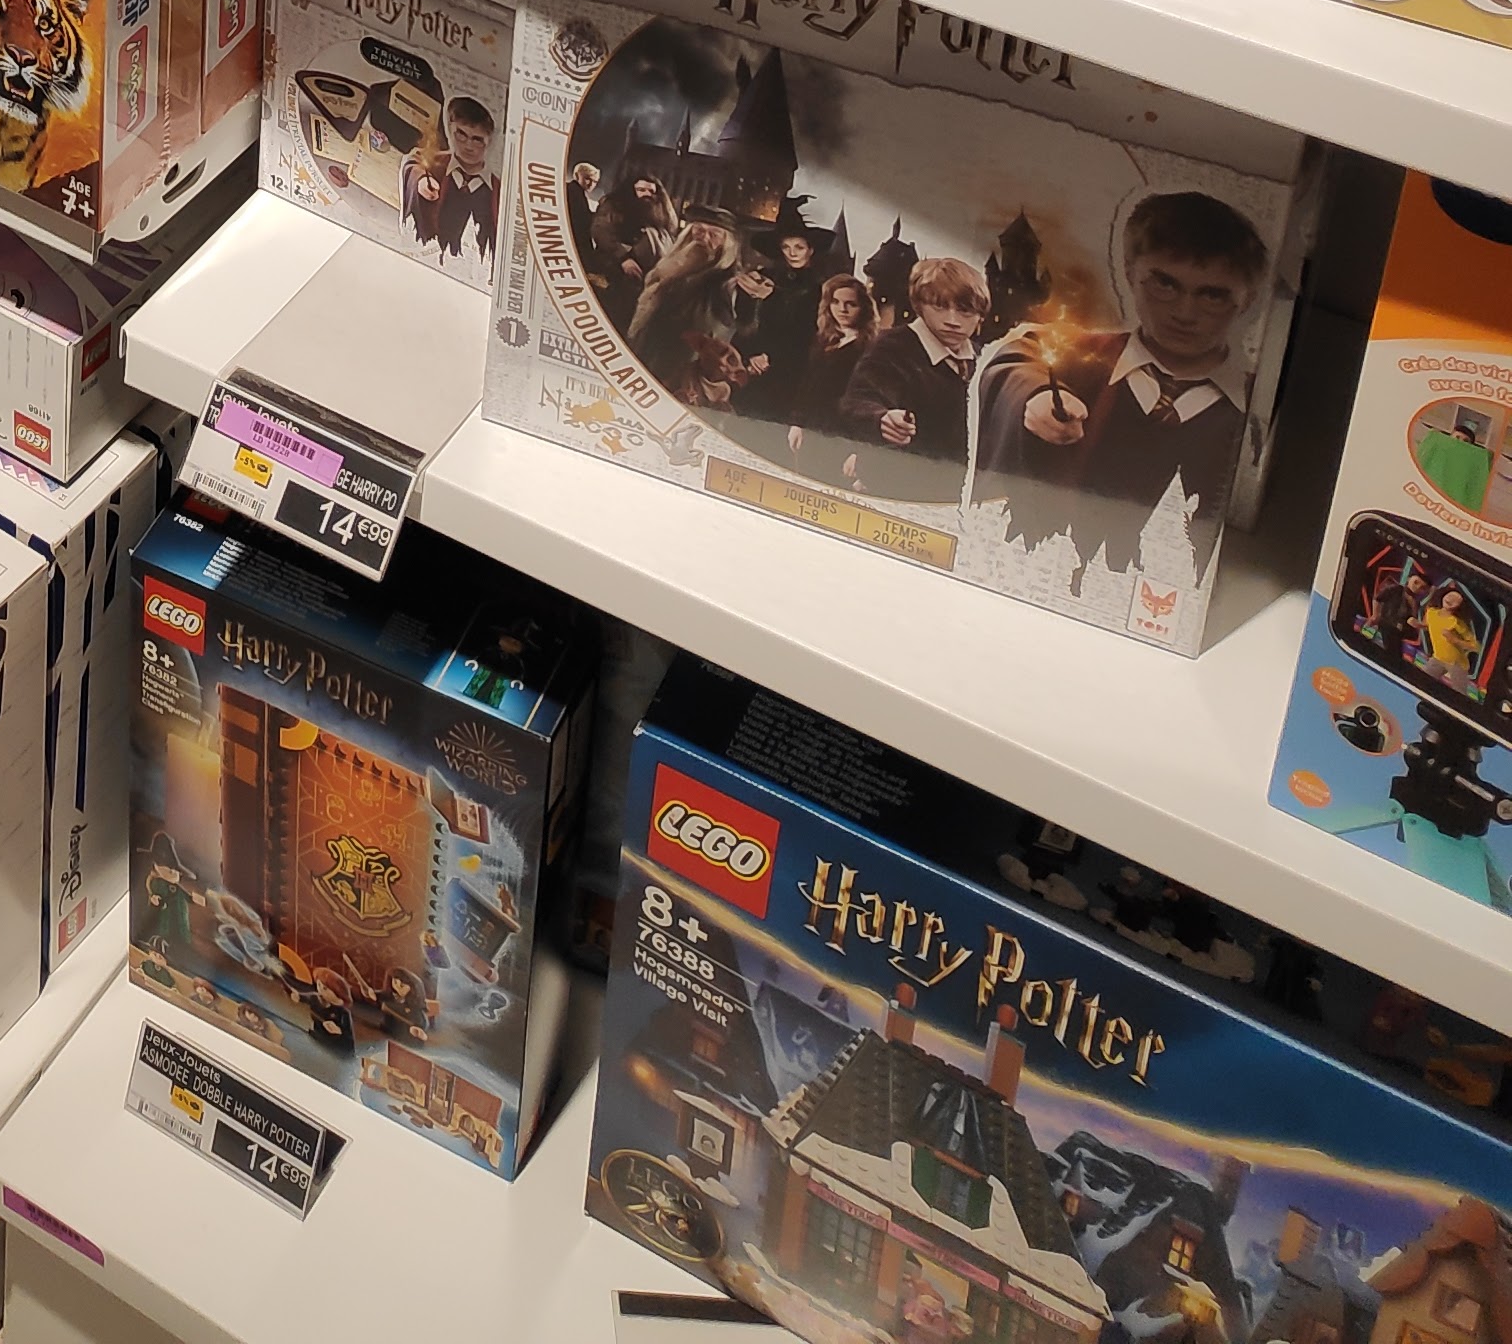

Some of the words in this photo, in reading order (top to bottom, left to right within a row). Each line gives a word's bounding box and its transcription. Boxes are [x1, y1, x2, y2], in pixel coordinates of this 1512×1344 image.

[369, 53, 424, 81] PURSUIT
[370, 44, 423, 73] TRIVIAL
[60, 187, 95, 219] 7+
[68, 175, 92, 198] ÂGE
[526, 161, 558, 205] UNE
[569, 299, 662, 411] POUDLARD
[783, 485, 839, 516] JOUEURS
[883, 518, 928, 545] TEMPS
[147, 596, 201, 634] LEGO
[142, 640, 175, 669] 8+
[216, 618, 302, 688] Harry
[306, 650, 393, 726] Potter
[443, 757, 518, 797] WORLD
[654, 797, 772, 884] LEGO
[639, 882, 711, 946] 8+
[635, 921, 716, 984] 76388
[798, 855, 974, 990] Harry
[978, 922, 1168, 1087] Potter
[631, 962, 689, 1008] Village
[691, 992, 729, 1030] Visit
[144, 1027, 222, 1086] Jeux-Jouets
[140, 1045, 190, 1085] ASMODEE
[191, 1074, 234, 1116] DOBBLE
[232, 1097, 270, 1139] HARRY
[267, 1117, 312, 1162] POTTER
